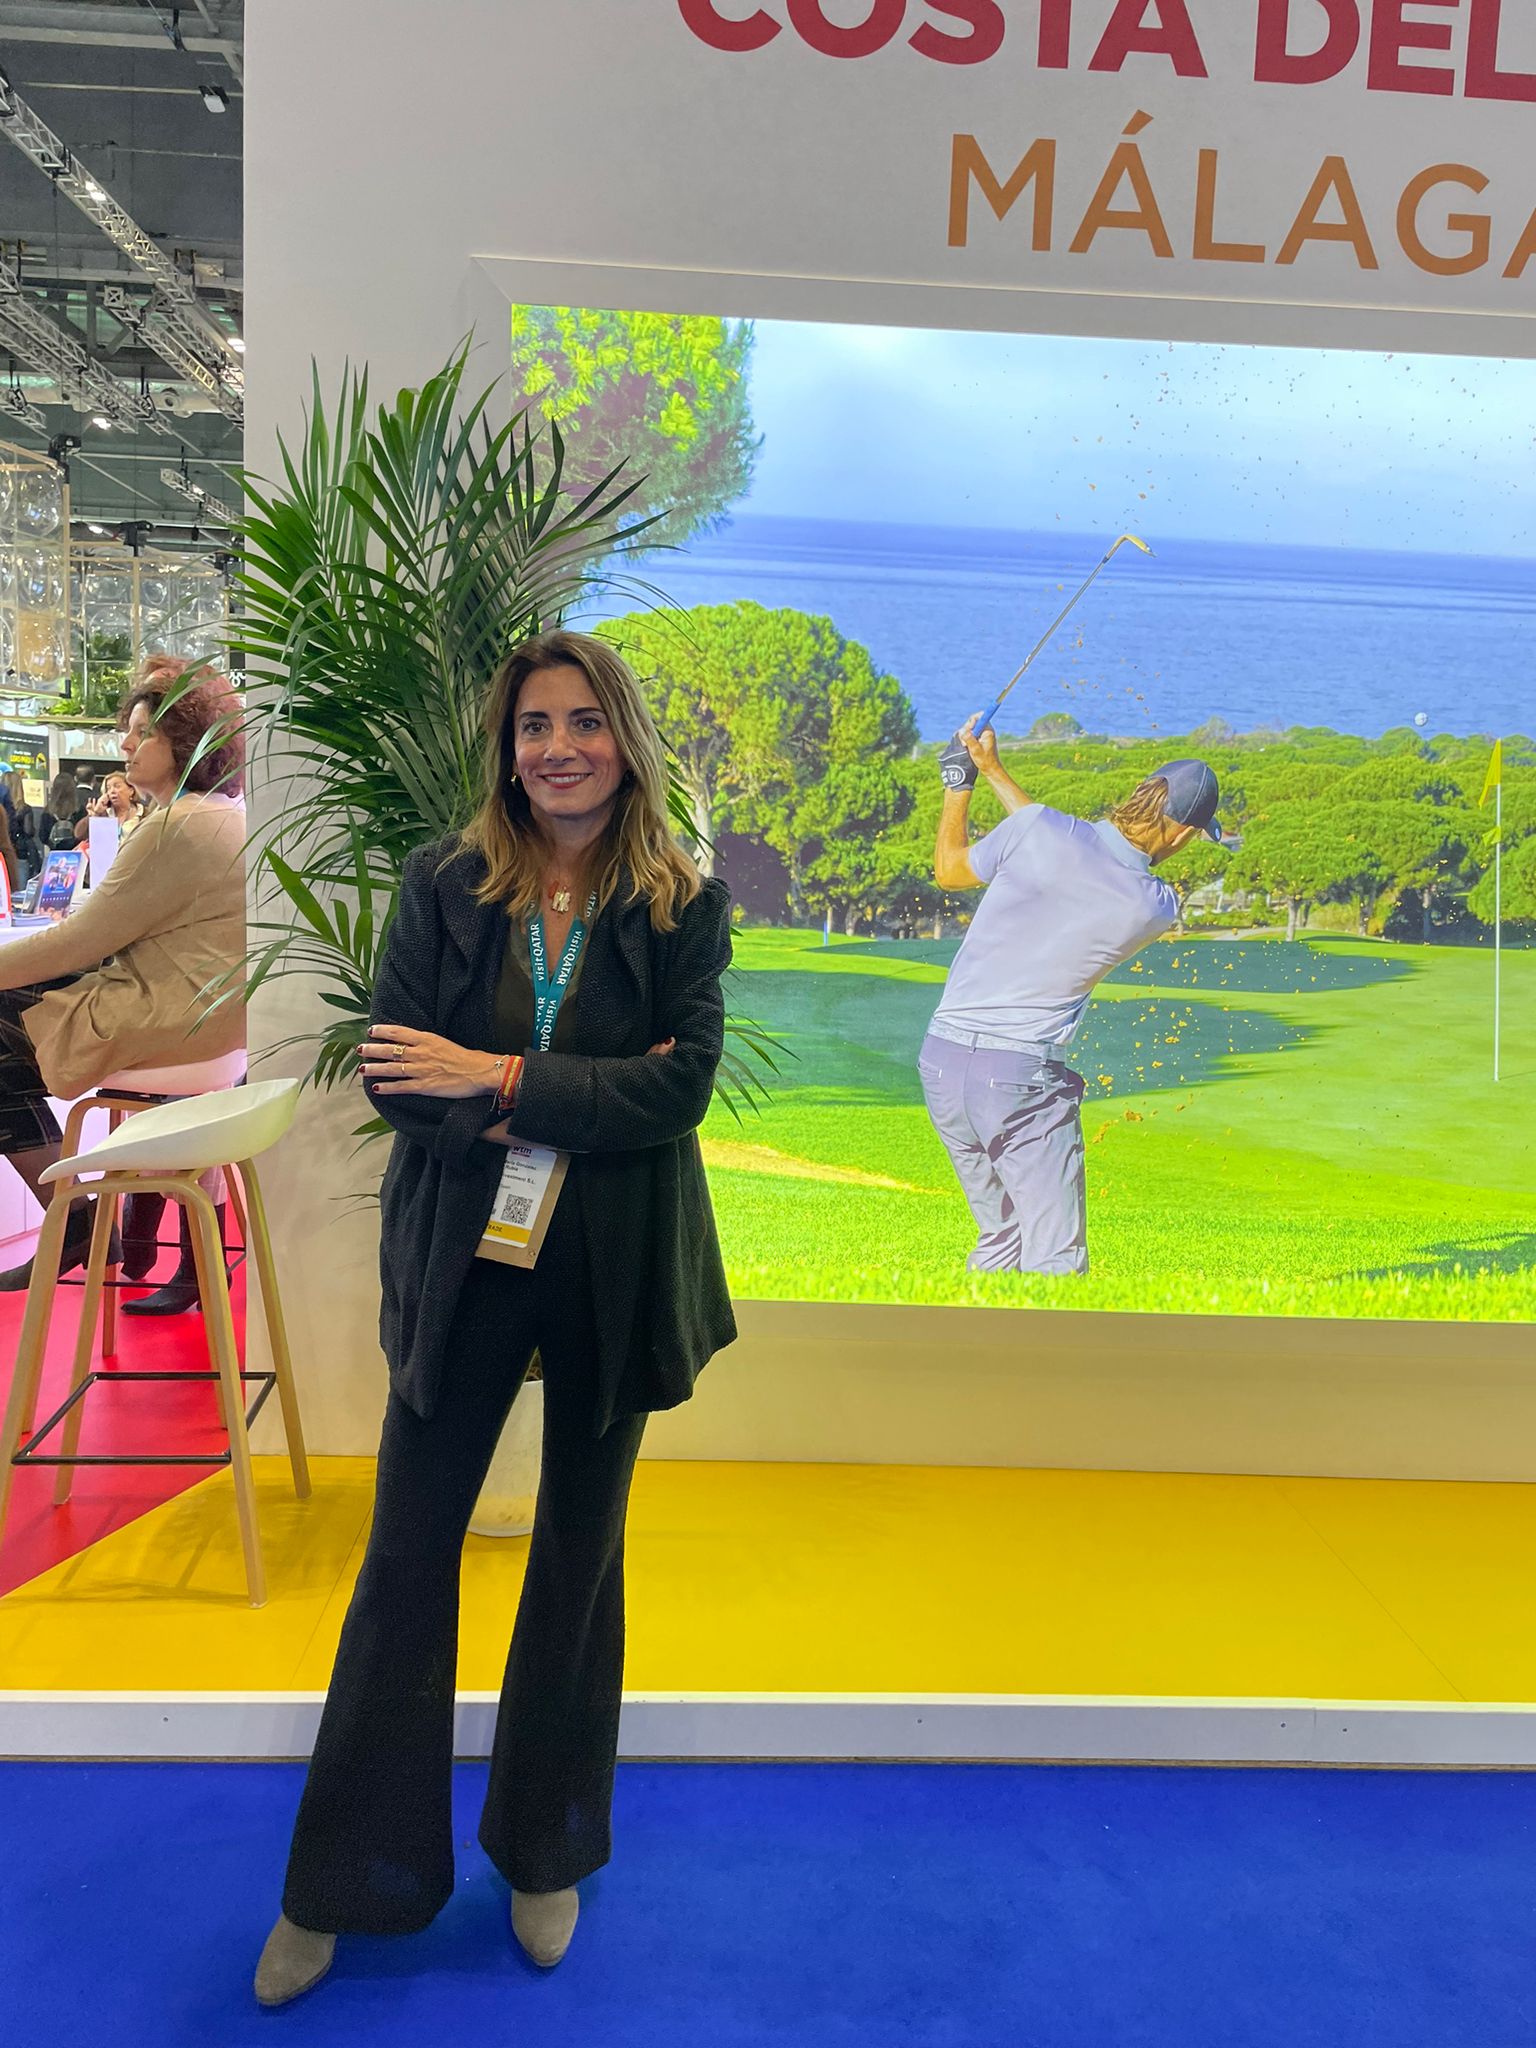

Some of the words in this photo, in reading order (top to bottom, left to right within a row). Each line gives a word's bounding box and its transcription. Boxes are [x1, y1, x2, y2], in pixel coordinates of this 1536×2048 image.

[1254, 0, 1536, 102] DEL
[948, 109, 1536, 278] MÁLAG
[530, 923, 545, 981] visitQATAR
[556, 931, 583, 986] visitQATAR
